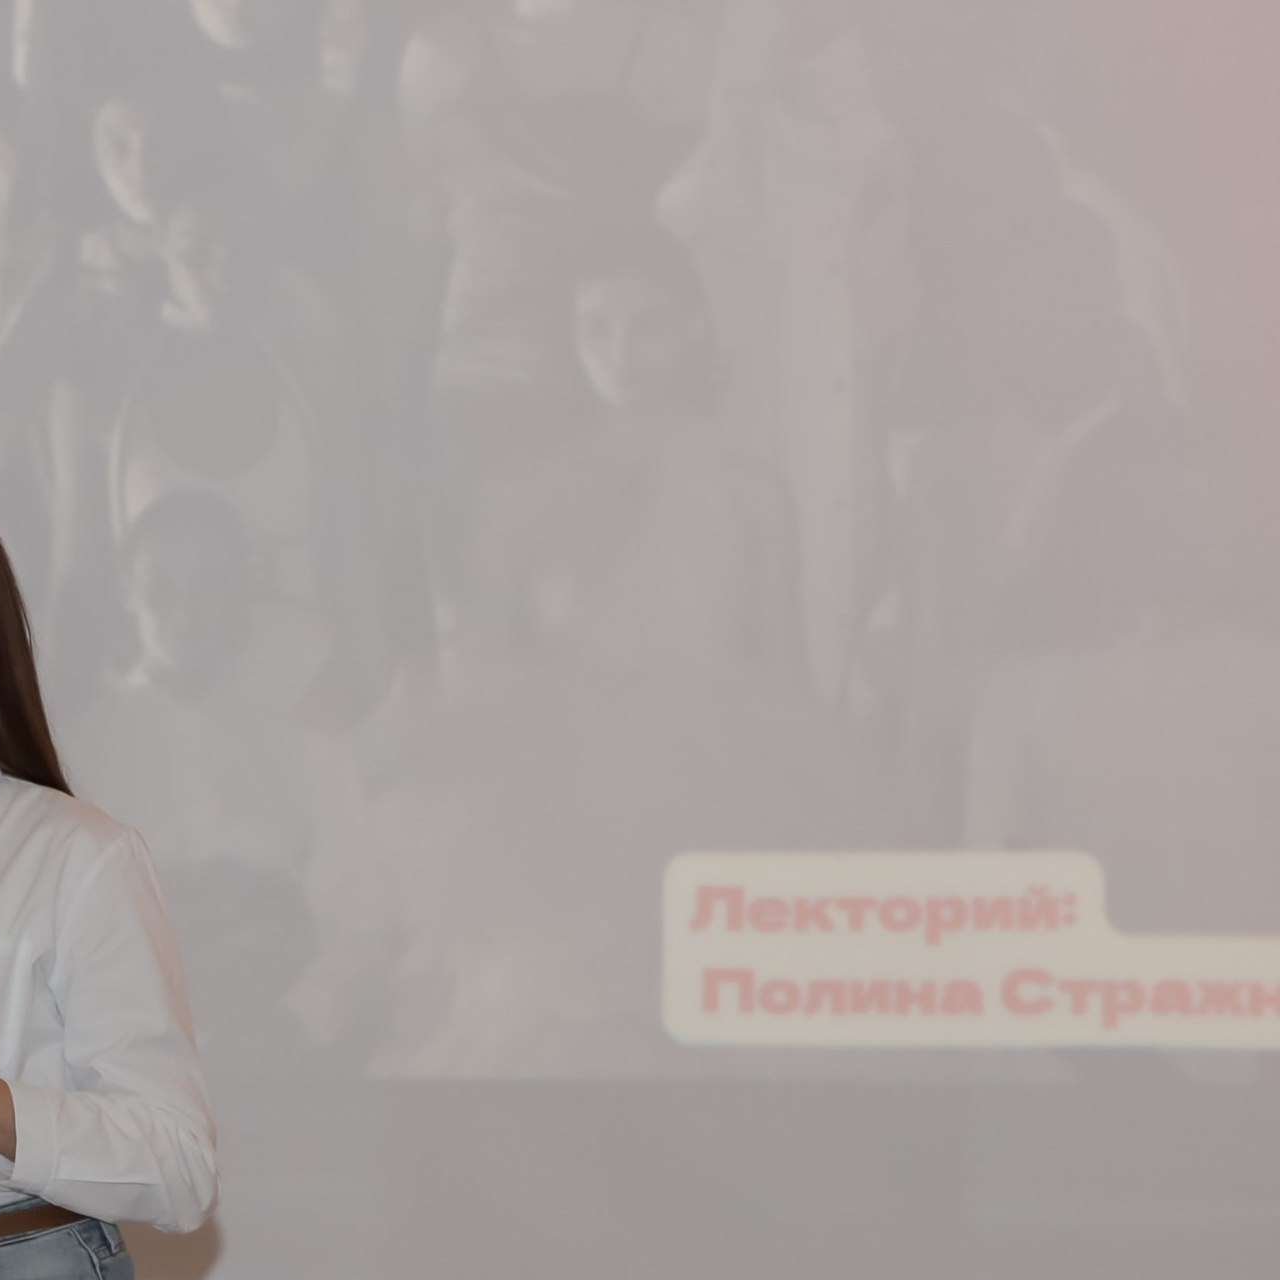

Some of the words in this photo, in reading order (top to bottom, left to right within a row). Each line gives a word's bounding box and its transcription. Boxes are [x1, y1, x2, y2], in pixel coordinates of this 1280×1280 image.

[689, 884, 1079, 947] Лекторий:
[701, 966, 986, 1018] Полина
[1000, 966, 1280, 1030] Стражн
